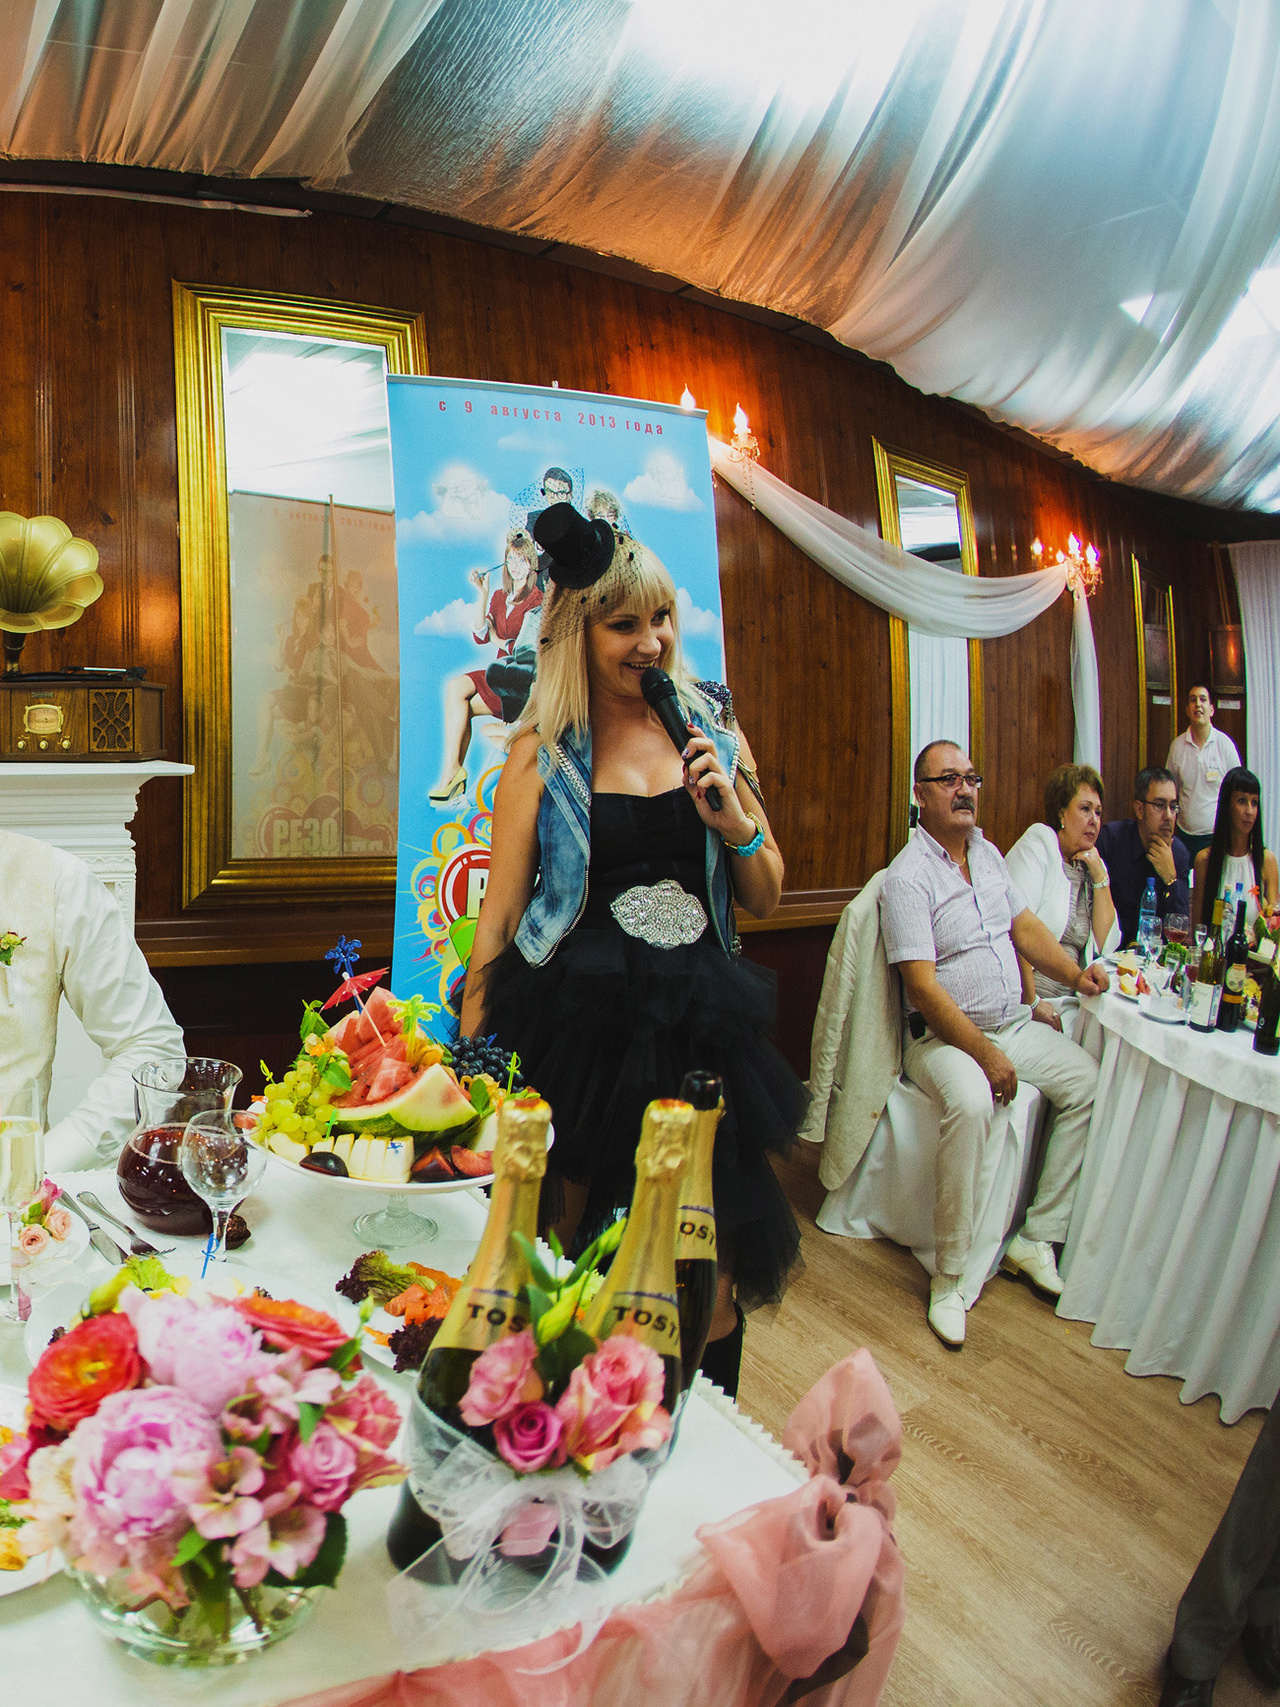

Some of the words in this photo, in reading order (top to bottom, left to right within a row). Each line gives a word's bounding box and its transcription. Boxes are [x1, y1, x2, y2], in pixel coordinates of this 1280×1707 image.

[438, 400, 447, 412] с
[464, 400, 473, 413] 9
[490, 404, 562, 422] августа
[577, 411, 617, 429] 2013
[625, 420, 664, 436] года
[679, 1220, 716, 1247] OST
[467, 1302, 528, 1333] TOS
[612, 1305, 679, 1340] TOST
